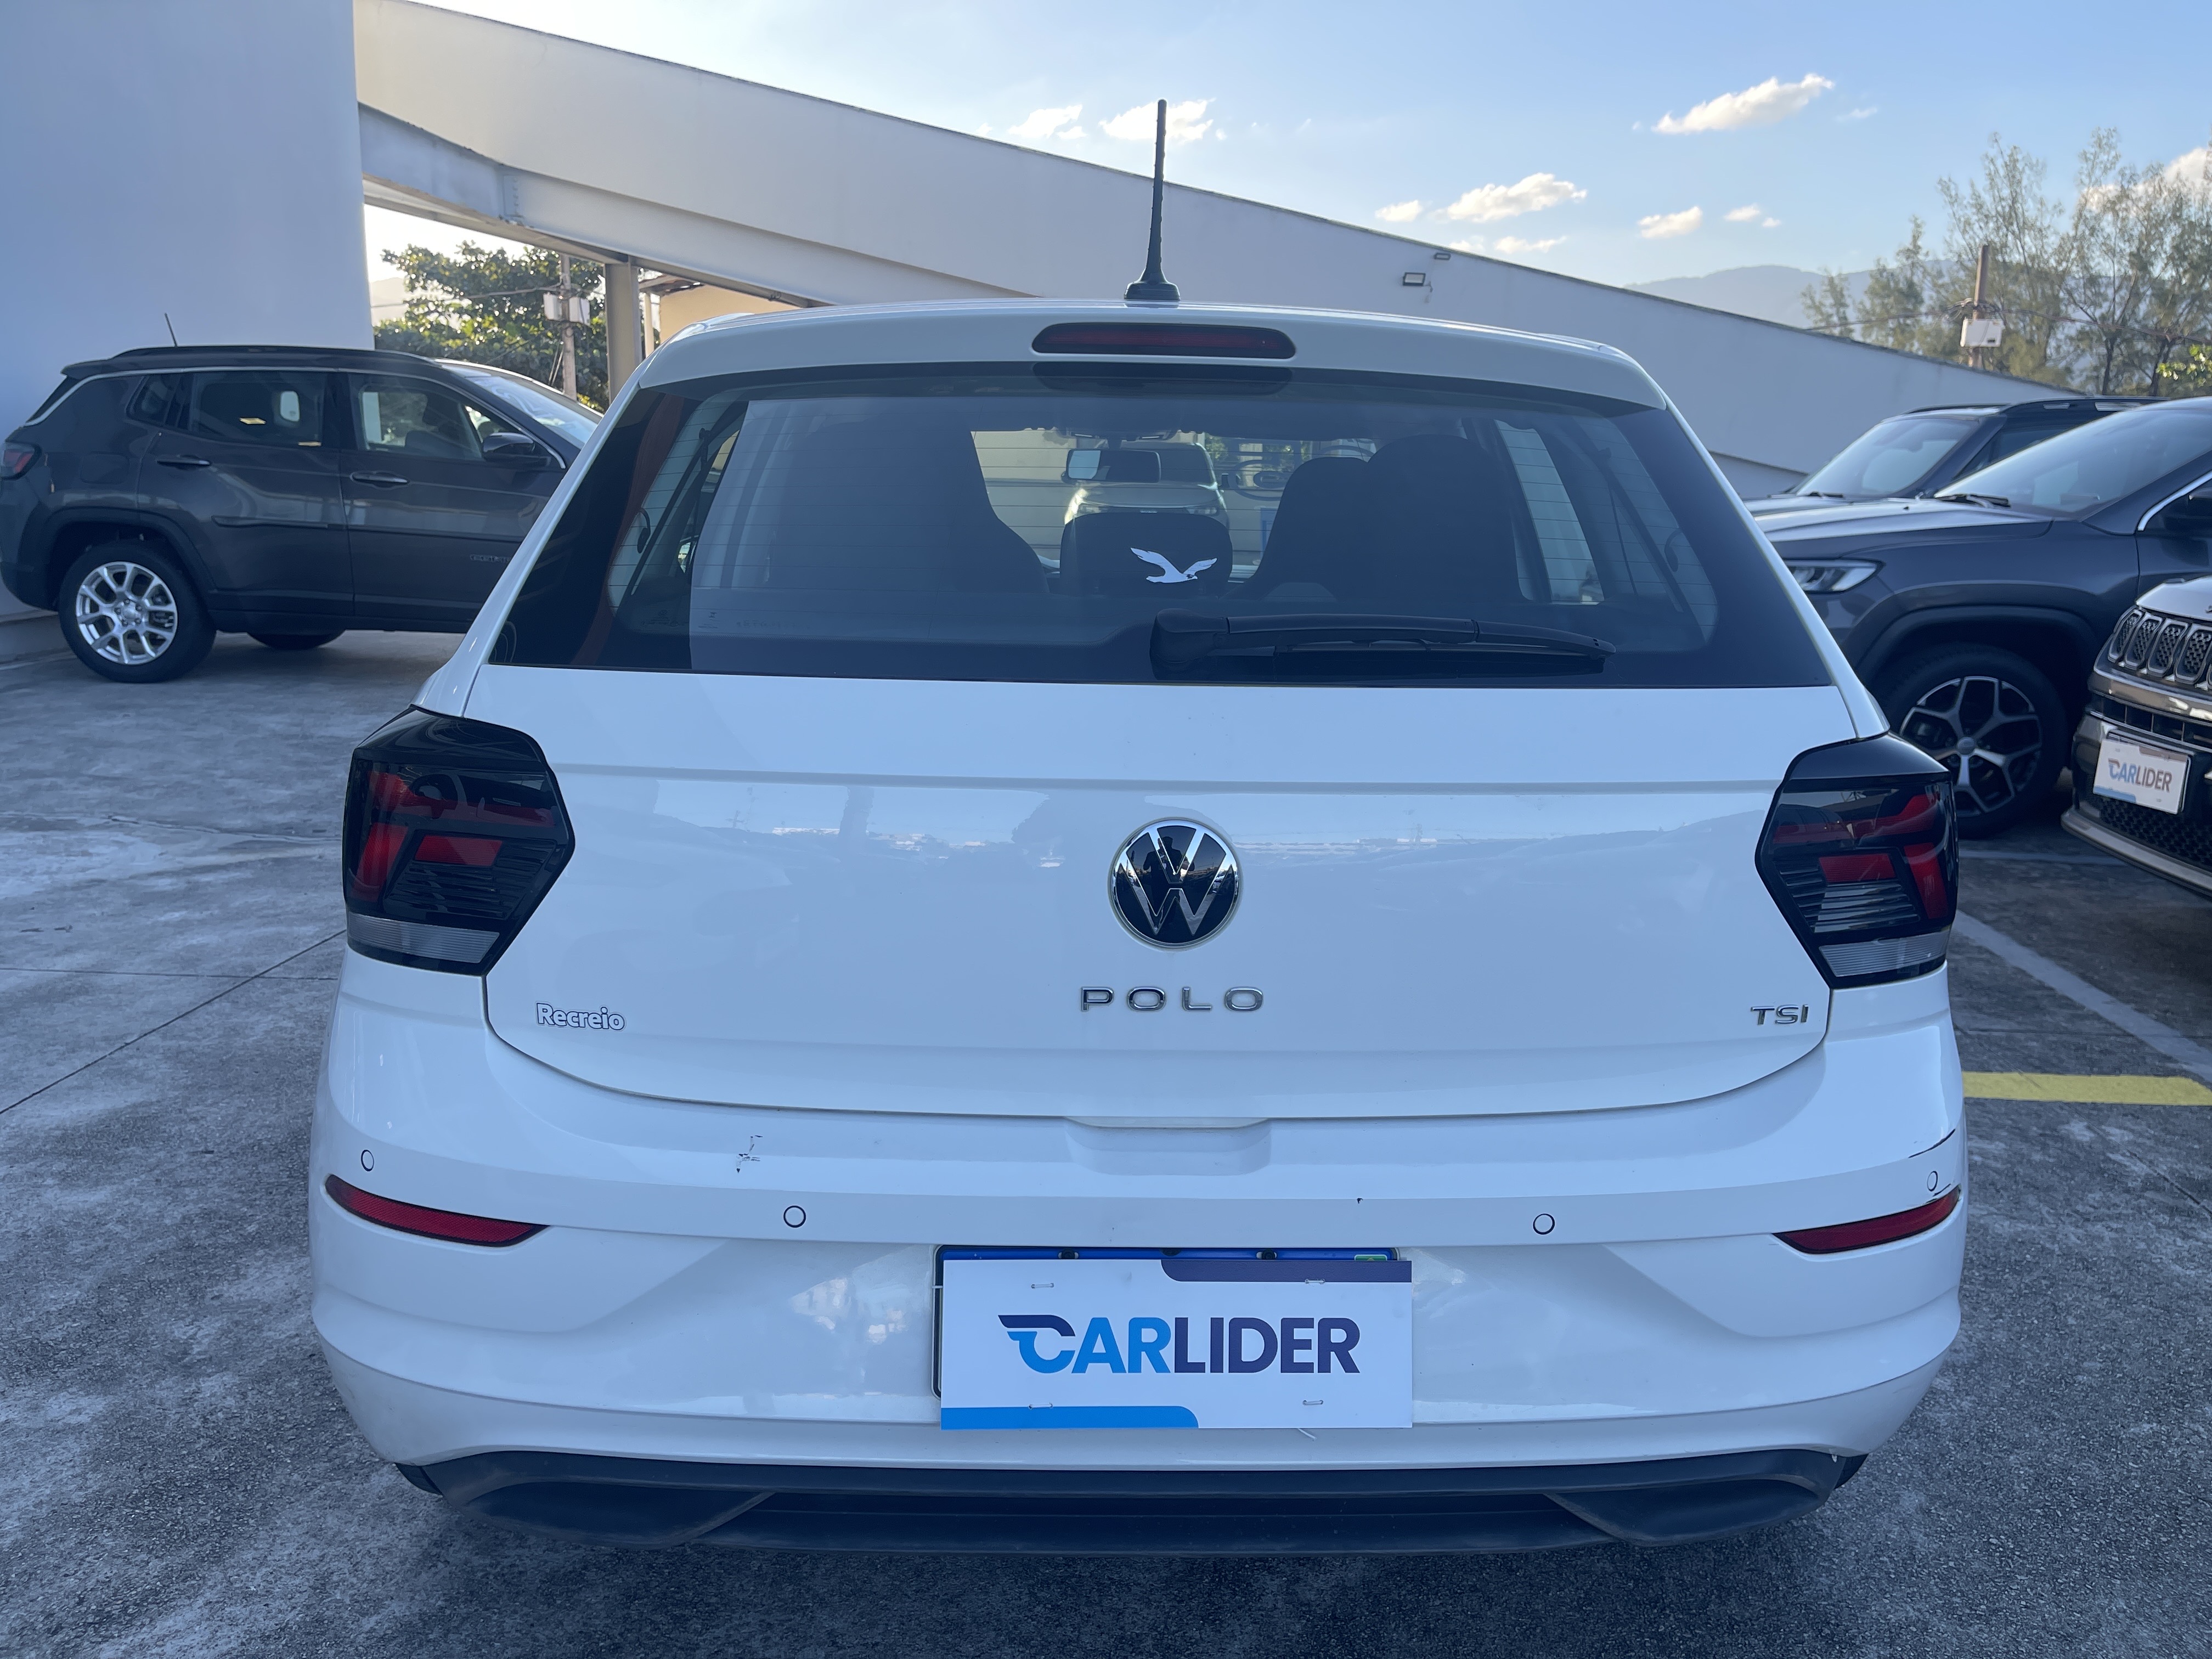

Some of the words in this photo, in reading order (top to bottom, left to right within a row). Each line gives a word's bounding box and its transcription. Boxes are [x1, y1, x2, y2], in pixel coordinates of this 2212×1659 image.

[2108, 758, 2172, 793] CARLIDER
[1081, 986, 1263, 1012] POLO
[536, 1002, 625, 1031] Recreio
[1750, 1004, 1809, 1025] TSI
[998, 1314, 1360, 1374] CARLIDER
